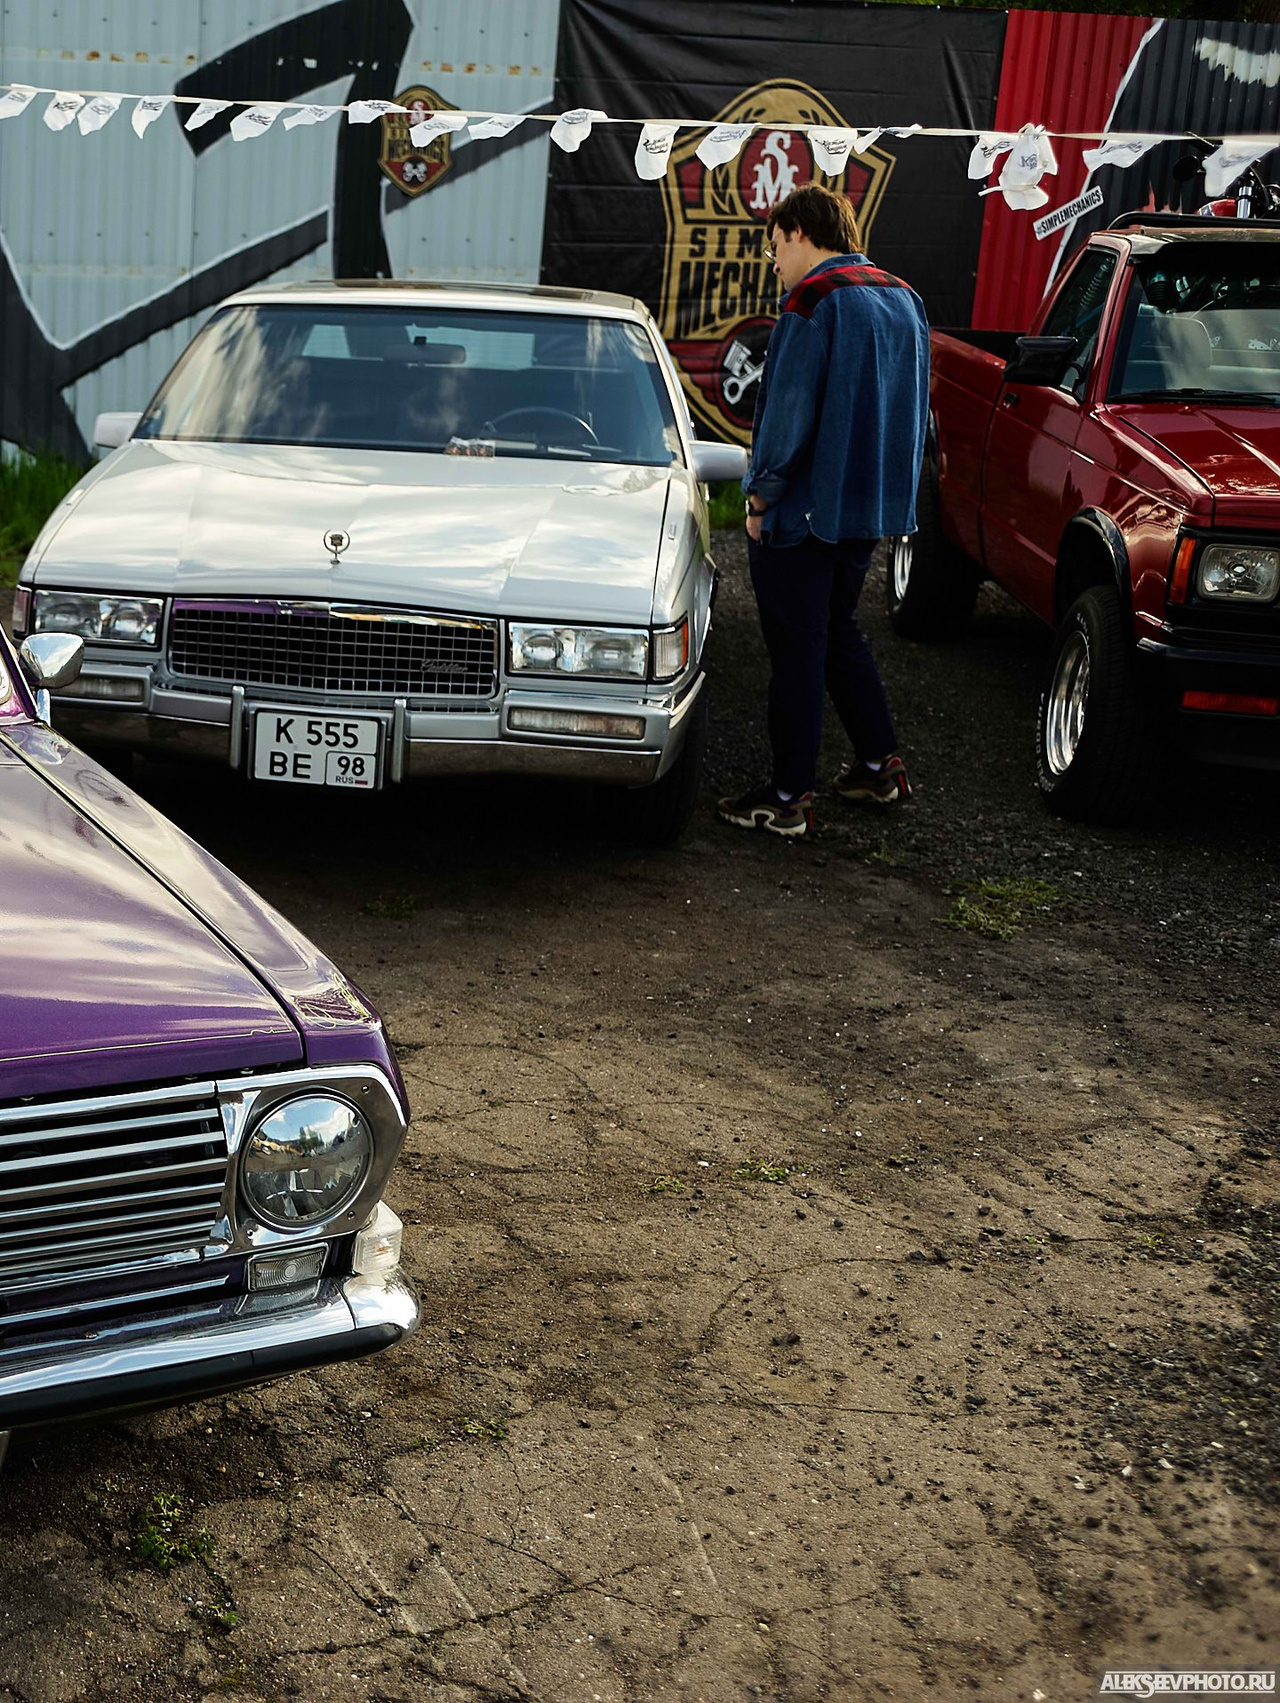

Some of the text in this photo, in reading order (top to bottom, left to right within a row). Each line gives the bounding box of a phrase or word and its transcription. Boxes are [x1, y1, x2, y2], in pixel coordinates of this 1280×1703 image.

[1036, 189, 1102, 235] #SIMPLEMECHANICS
[307, 720, 359, 748] 555
[337, 755, 365, 776] 98
[335, 775, 354, 785] RUS
